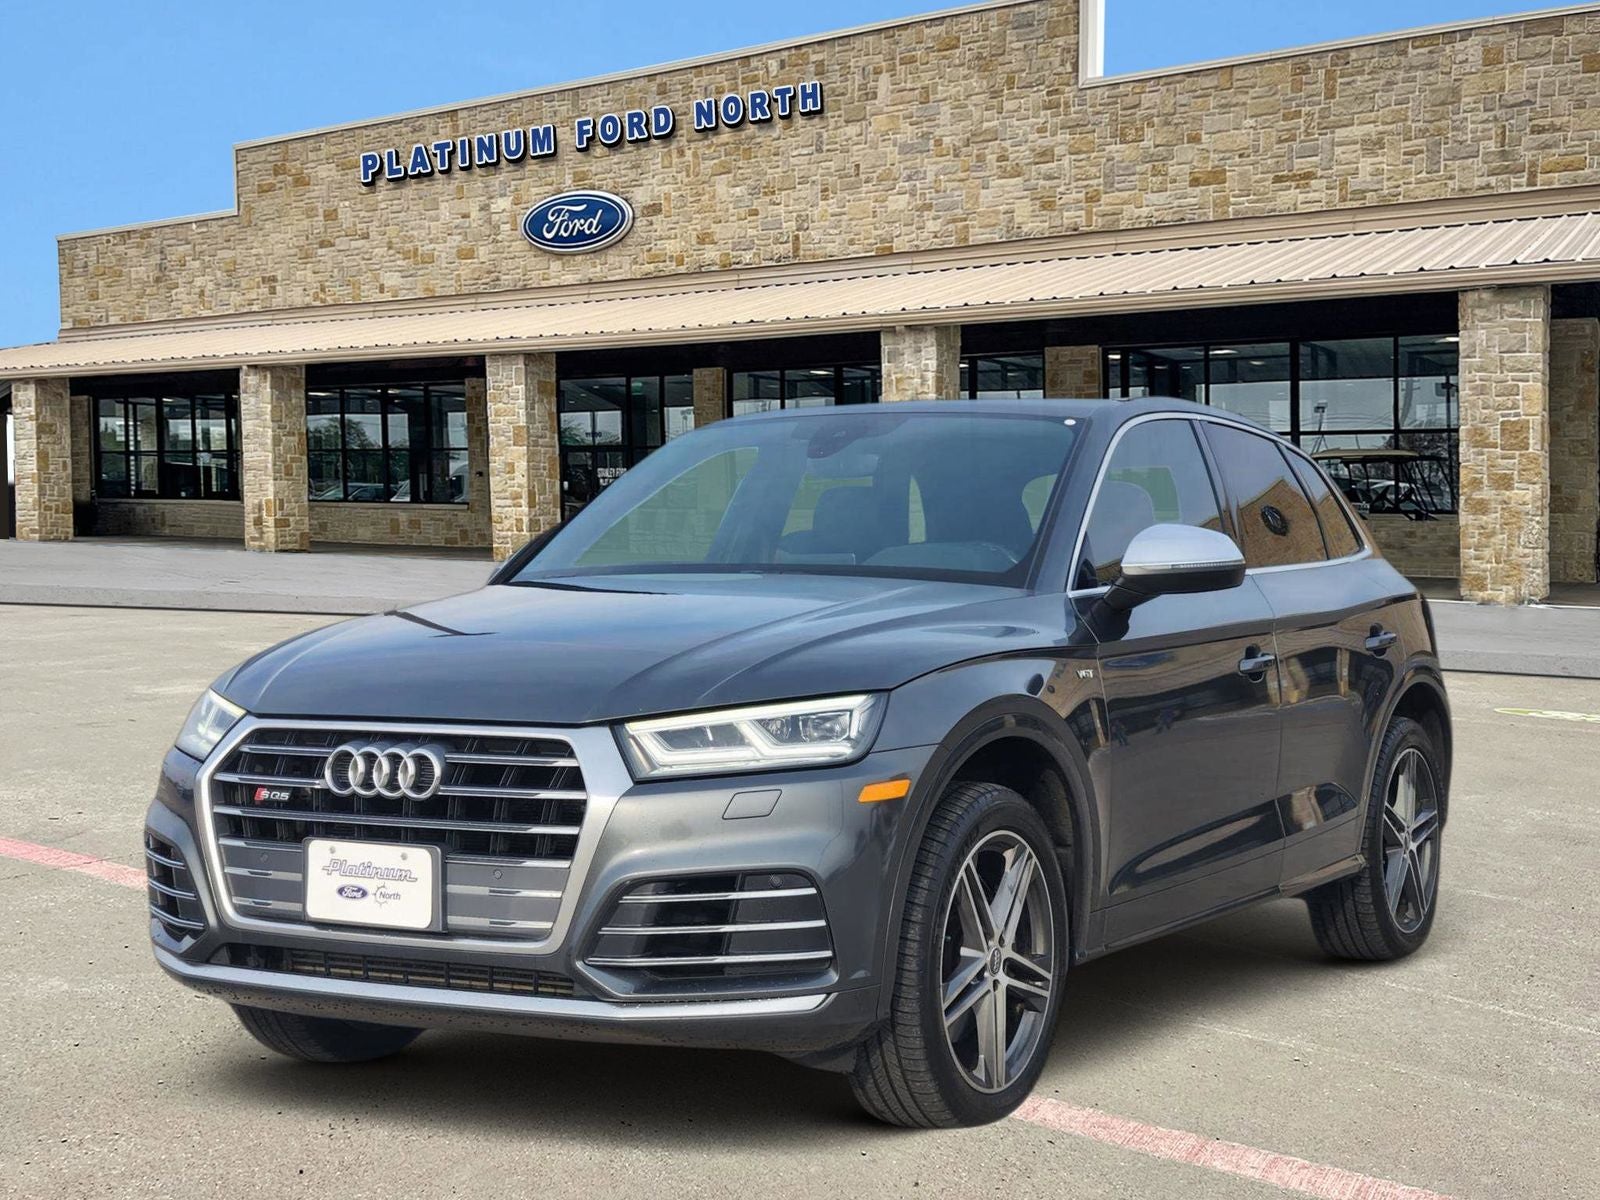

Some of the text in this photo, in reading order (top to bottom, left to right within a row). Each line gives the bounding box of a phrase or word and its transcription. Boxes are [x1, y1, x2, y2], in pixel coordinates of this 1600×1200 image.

[360, 81, 824, 186] PLATINUM FORD NORTH
[542, 204, 603, 239] Ford
[257, 788, 290, 801] SQ5
[321, 858, 418, 882] Platinum
[341, 886, 364, 899] Ford
[379, 890, 401, 901] North
